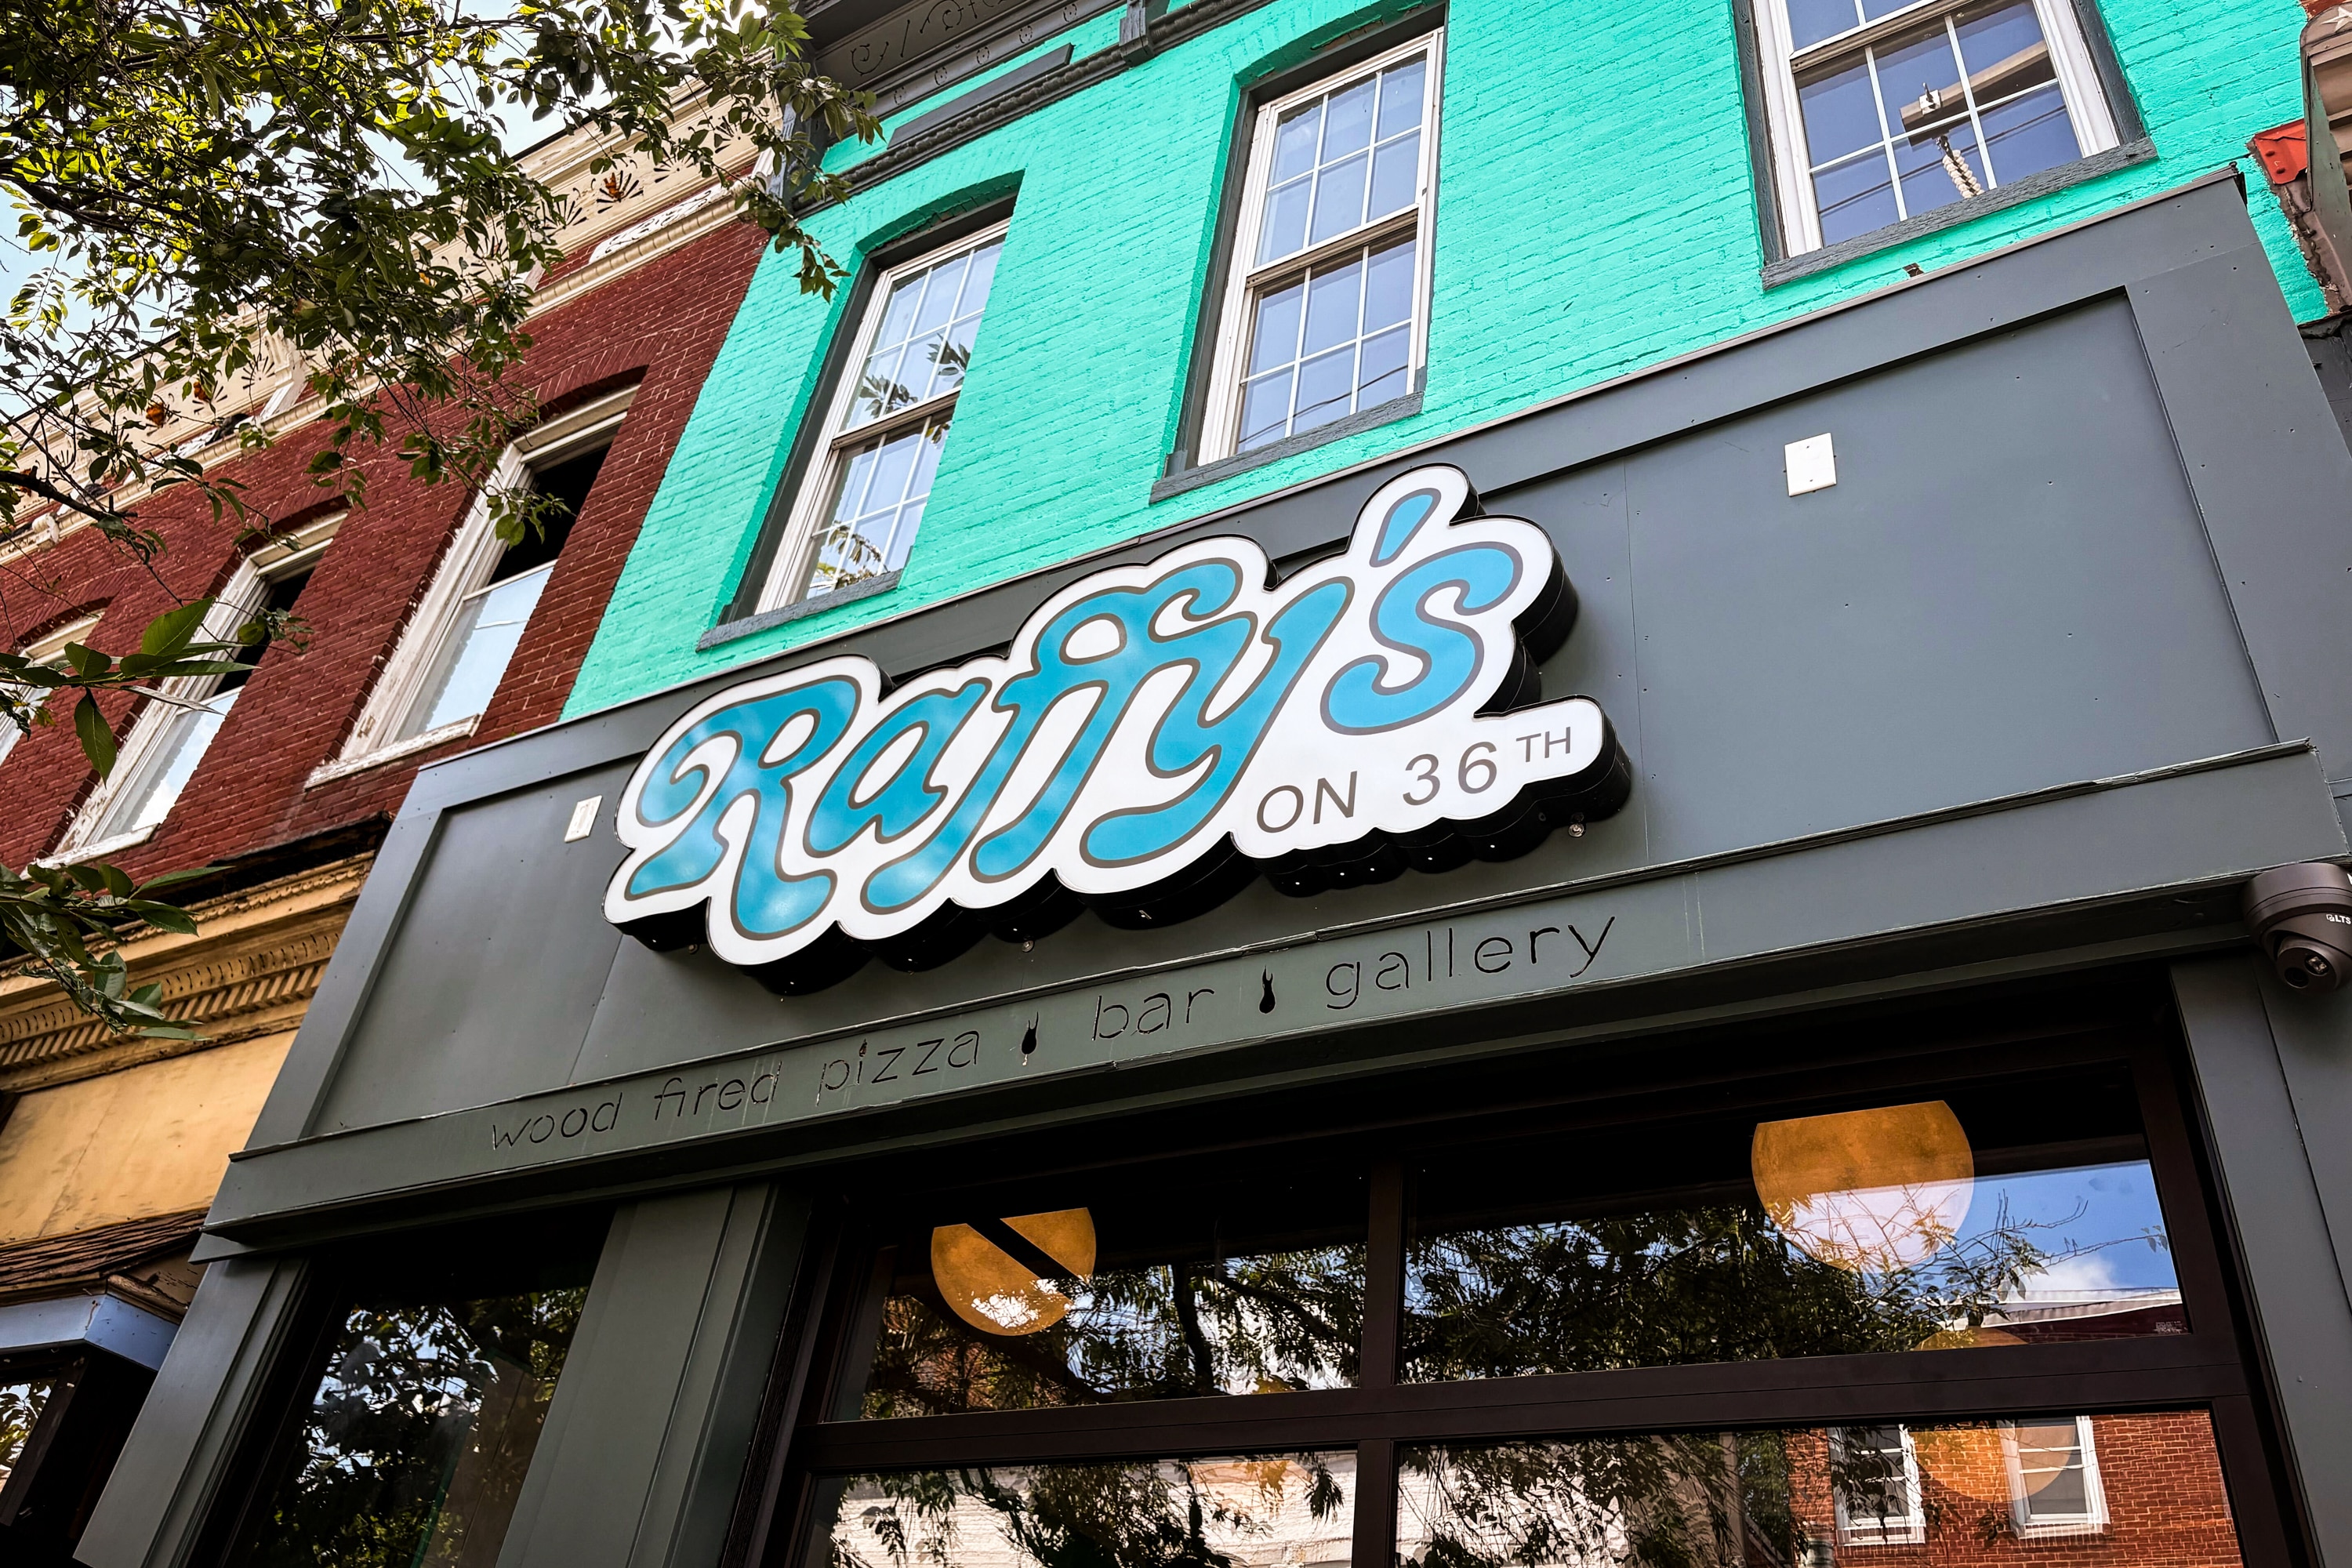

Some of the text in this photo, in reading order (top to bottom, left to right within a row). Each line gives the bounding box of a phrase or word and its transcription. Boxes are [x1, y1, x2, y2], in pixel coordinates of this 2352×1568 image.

[623, 485, 1524, 941] Raffy's
[1256, 771, 1358, 833] ON
[2334, 914, 2351, 925] LTS
[492, 916, 1615, 1151] wood fired pizza bar gallery
